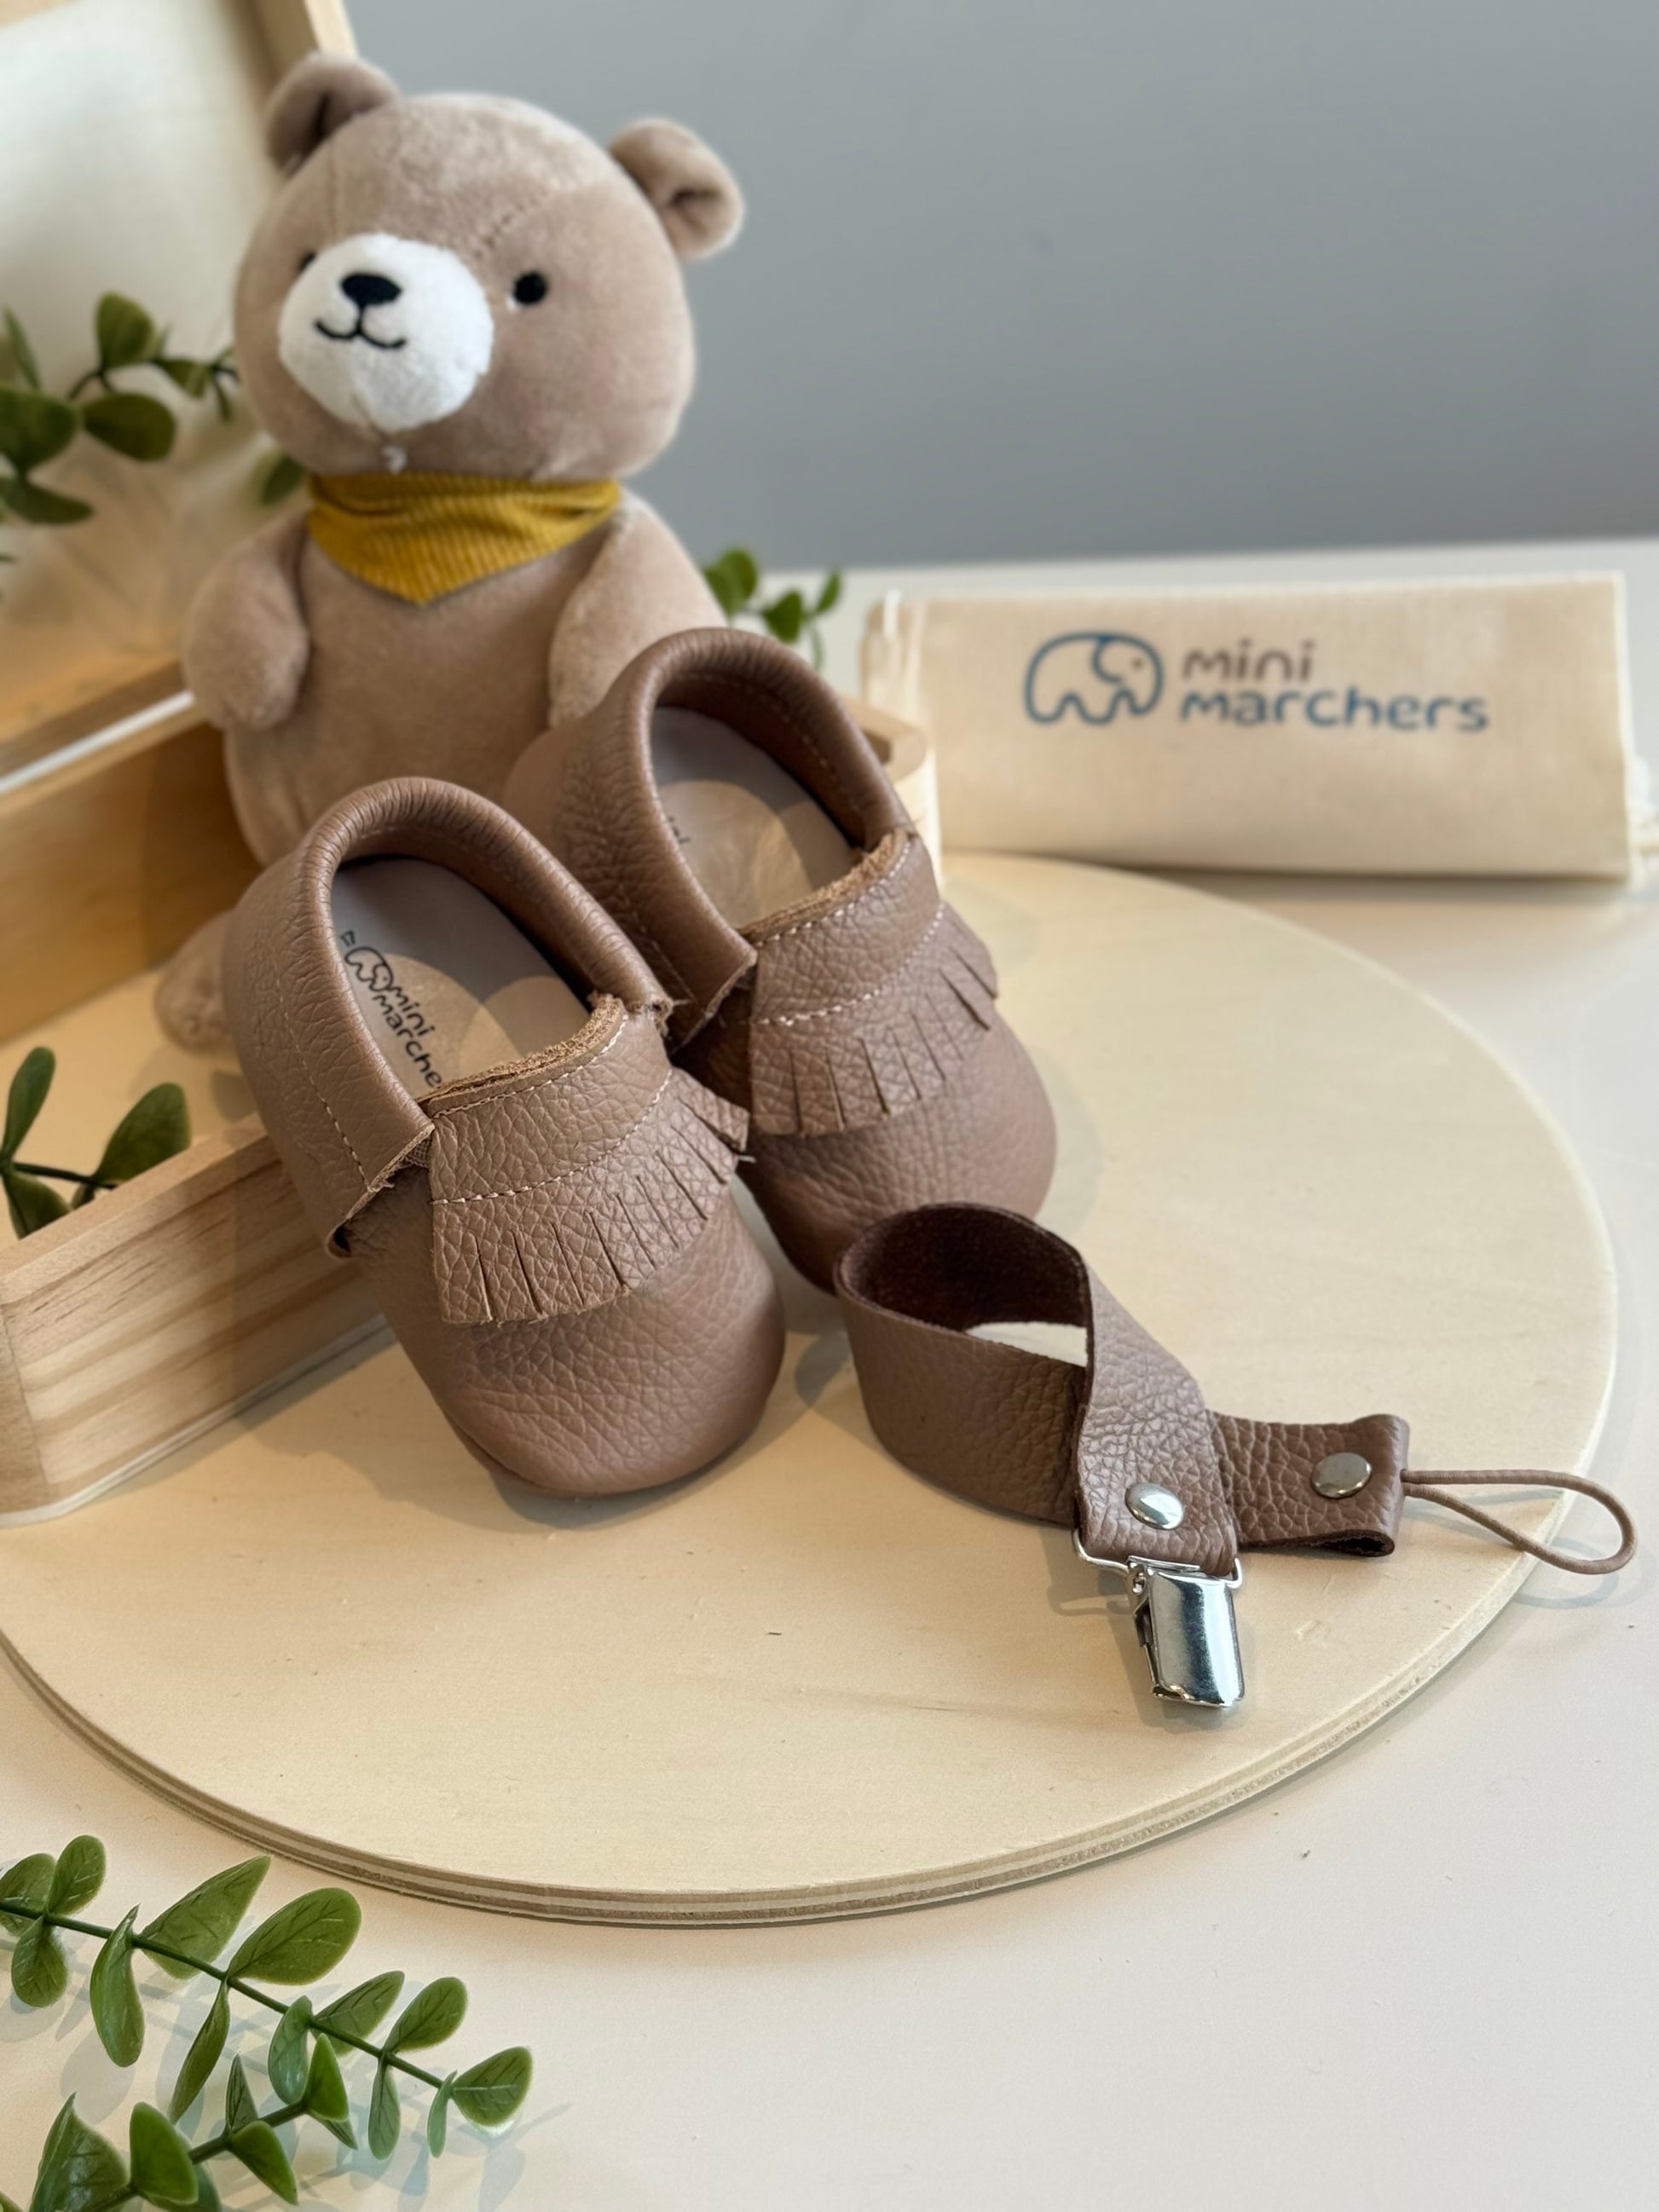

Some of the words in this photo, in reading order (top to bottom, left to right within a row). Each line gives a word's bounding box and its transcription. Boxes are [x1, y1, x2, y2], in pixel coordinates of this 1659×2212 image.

[1182, 638, 1316, 682] mini
[1180, 684, 1488, 732] marchers
[388, 985, 436, 1037] mini
[372, 994, 442, 1088] marche
